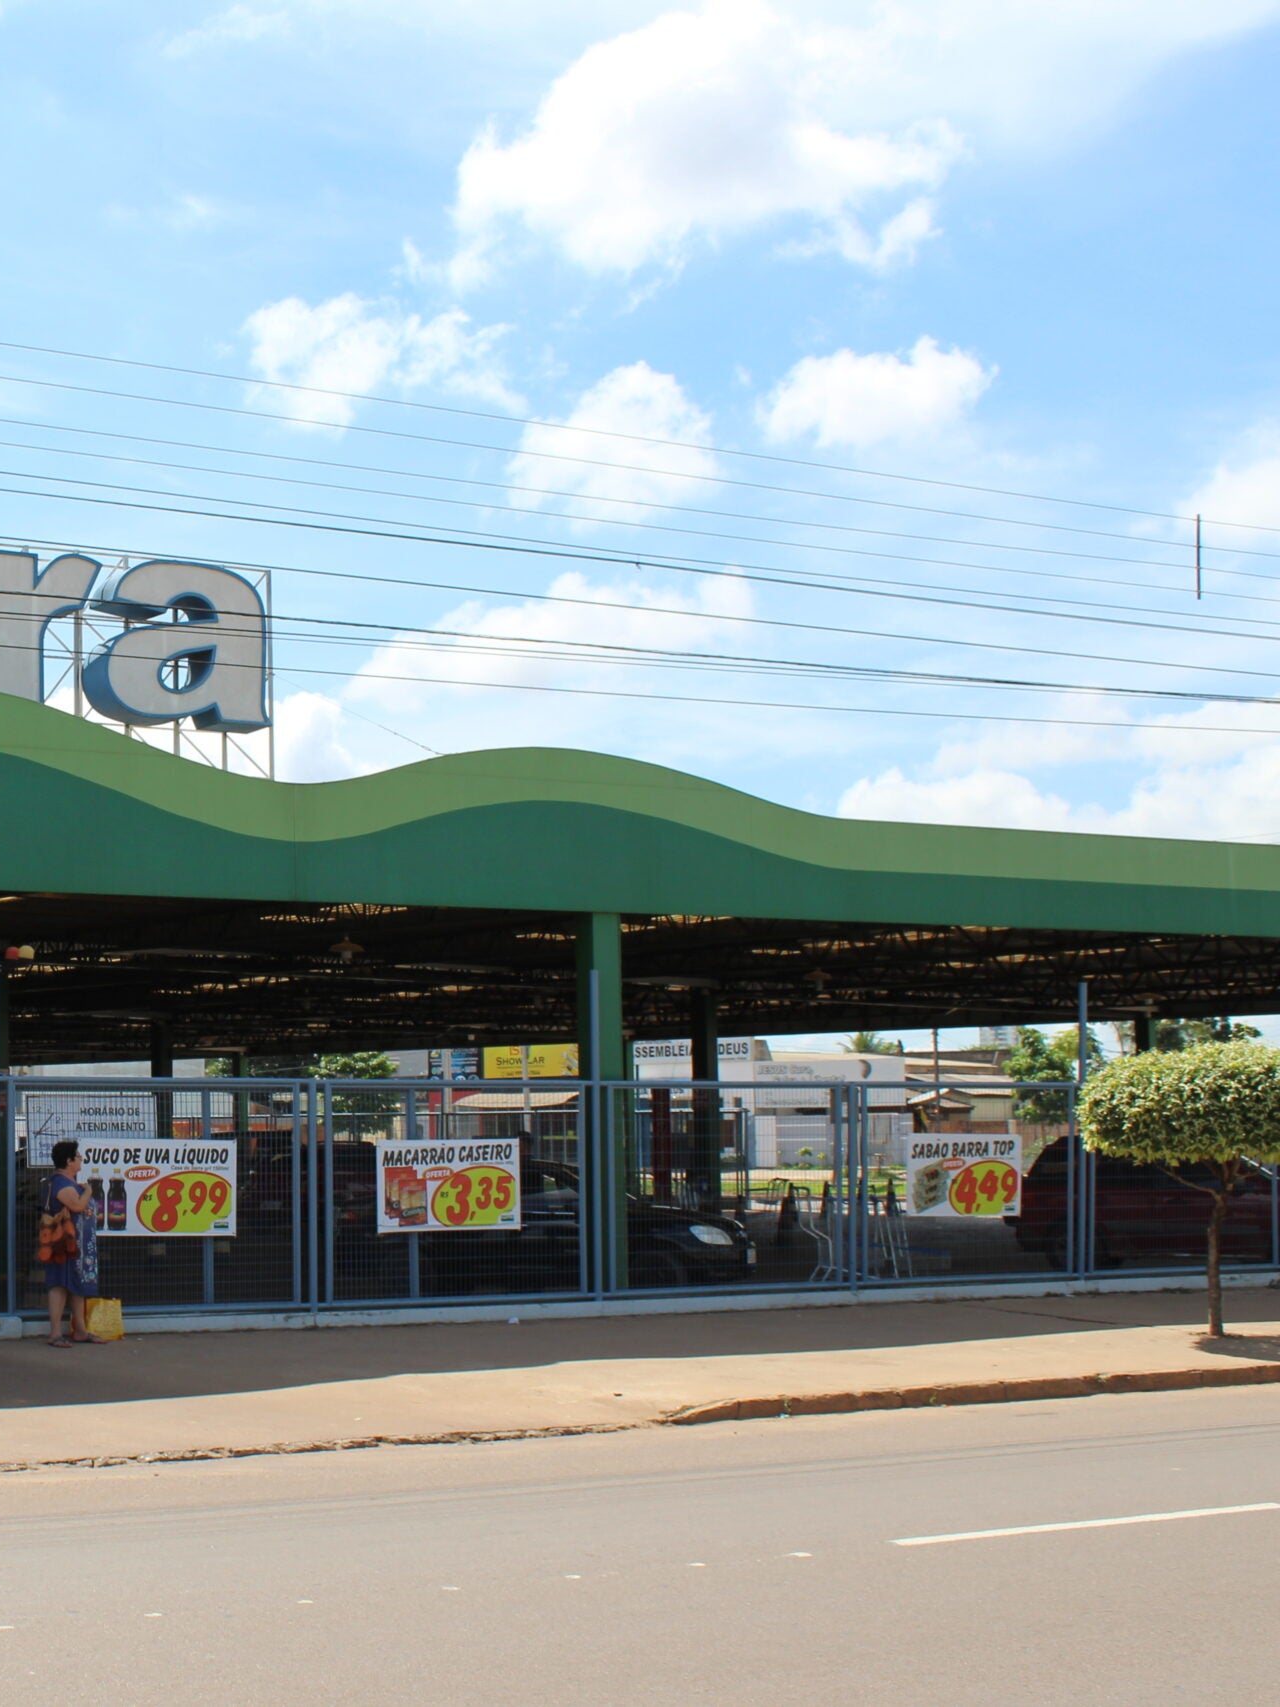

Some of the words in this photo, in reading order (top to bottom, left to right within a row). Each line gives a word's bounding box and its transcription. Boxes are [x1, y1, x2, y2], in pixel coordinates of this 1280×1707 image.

[718, 1042, 749, 1056] DEUS
[80, 1104, 125, 1117] HORÁRIO
[127, 1107, 140, 1117] DE
[76, 1121, 146, 1132] ATENDIMENTO
[83, 1148, 120, 1164] SUCO
[123, 1148, 142, 1164] DE
[145, 1148, 170, 1164] UVA
[174, 1143, 229, 1166] LÍQUIDO
[382, 1143, 455, 1167] MACARRÃO
[458, 1143, 513, 1162] CASEIRO
[911, 1138, 948, 1159] SABÃO
[951, 1141, 989, 1158] BARRA
[993, 1140, 1015, 1156] TOP
[128, 1168, 157, 1178] OFERTA
[446, 1173, 513, 1226] 3,35
[955, 1168, 1018, 1214] 4,49
[151, 1178, 228, 1232] 8,99
